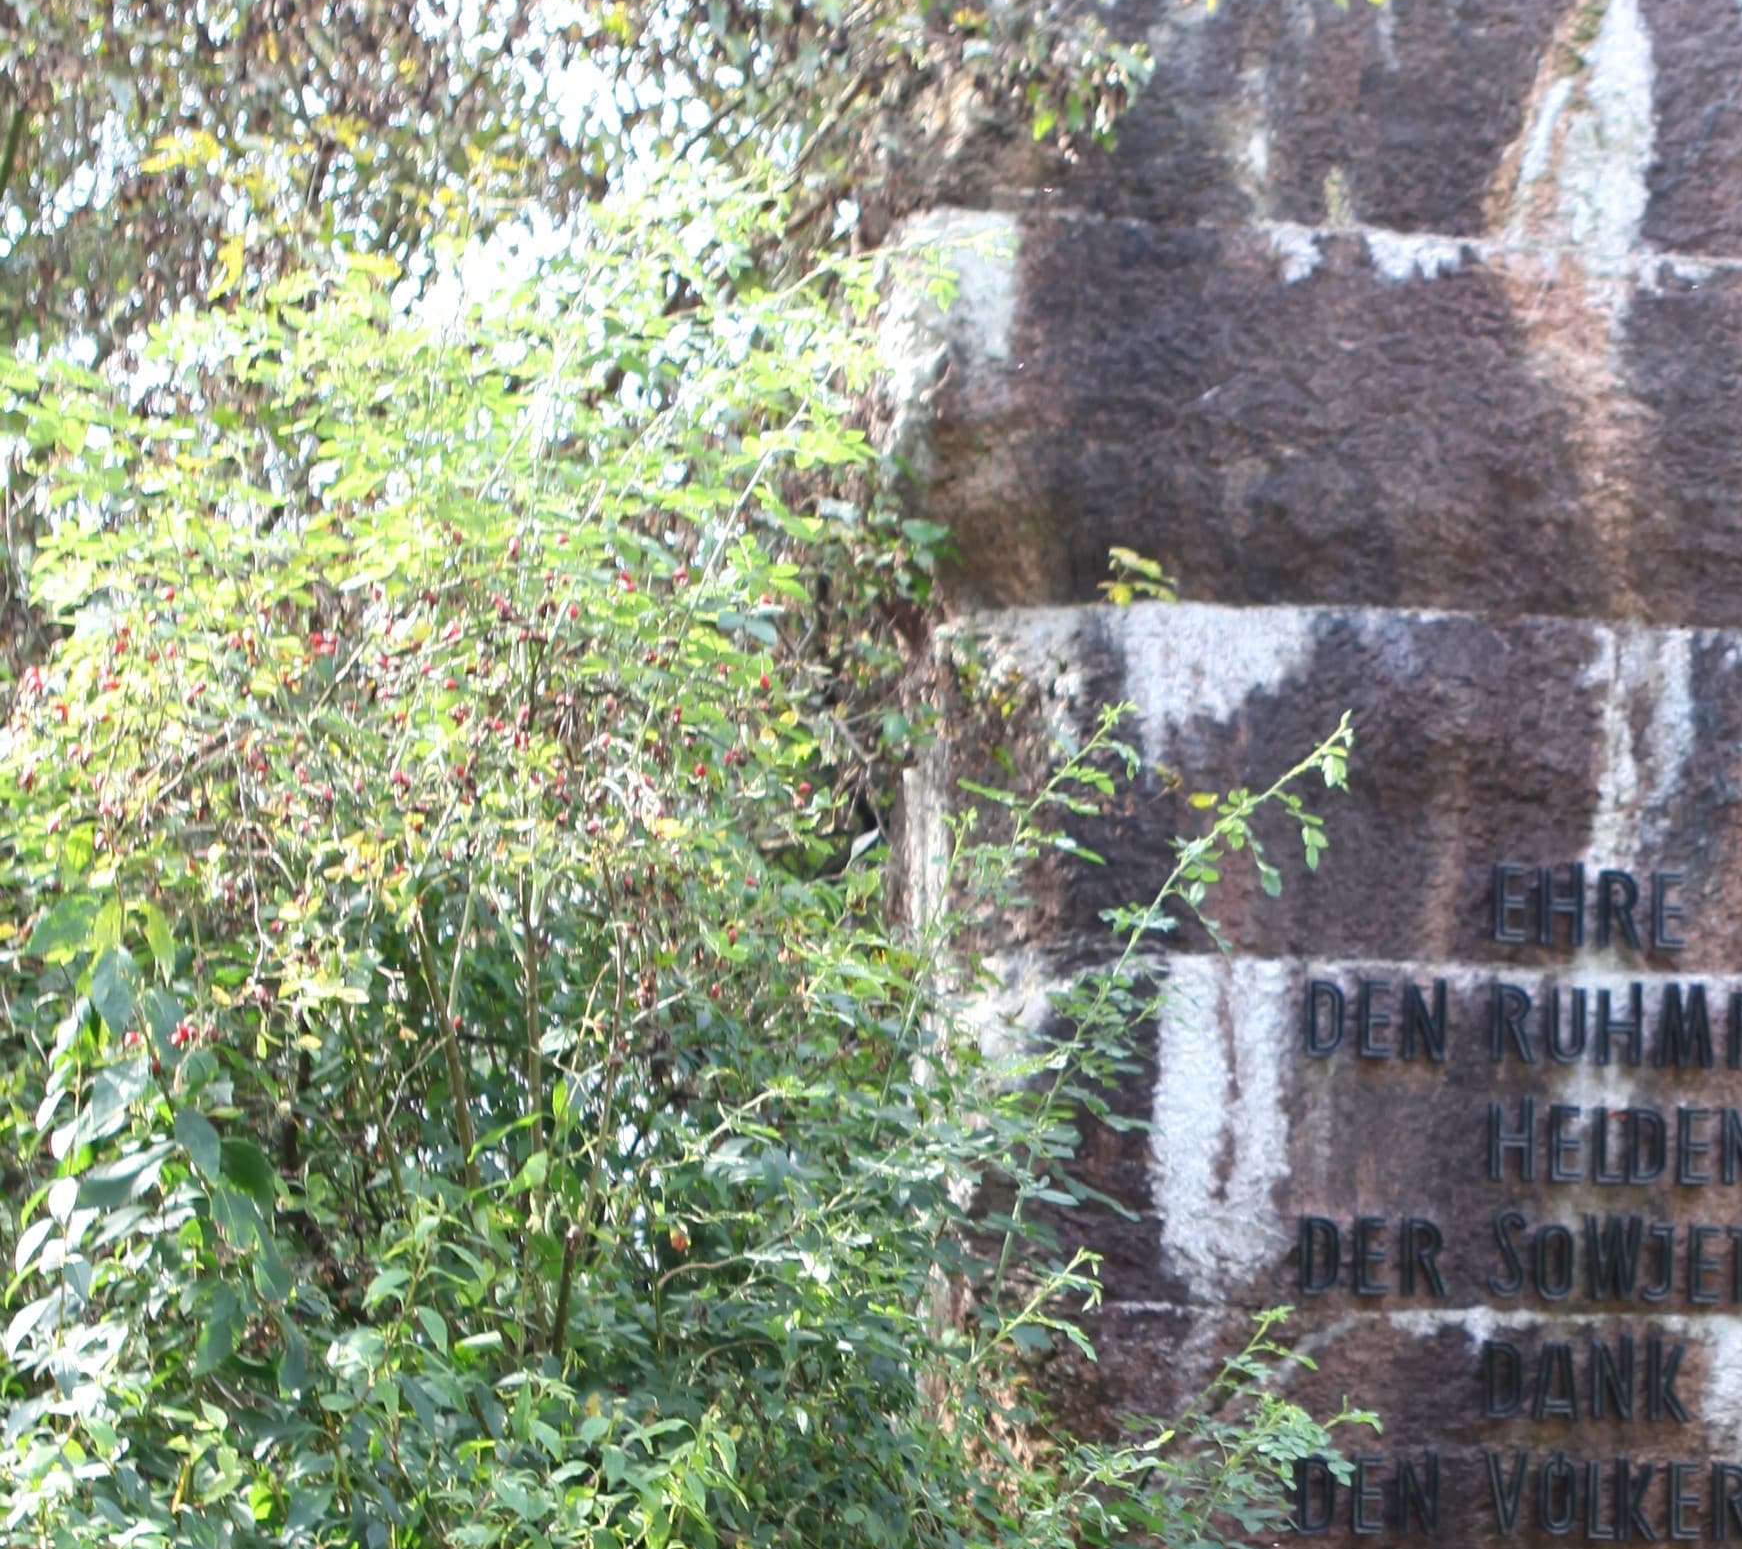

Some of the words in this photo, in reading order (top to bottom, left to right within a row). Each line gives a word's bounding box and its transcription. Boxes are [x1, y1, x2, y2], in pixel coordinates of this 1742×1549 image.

[1491, 860, 1688, 952] EHRE
[1304, 978, 1448, 1064] DEN
[1297, 1215, 1447, 1299] DER
[1482, 1334, 1692, 1424] DANK
[1295, 1450, 1441, 1537] DEN
